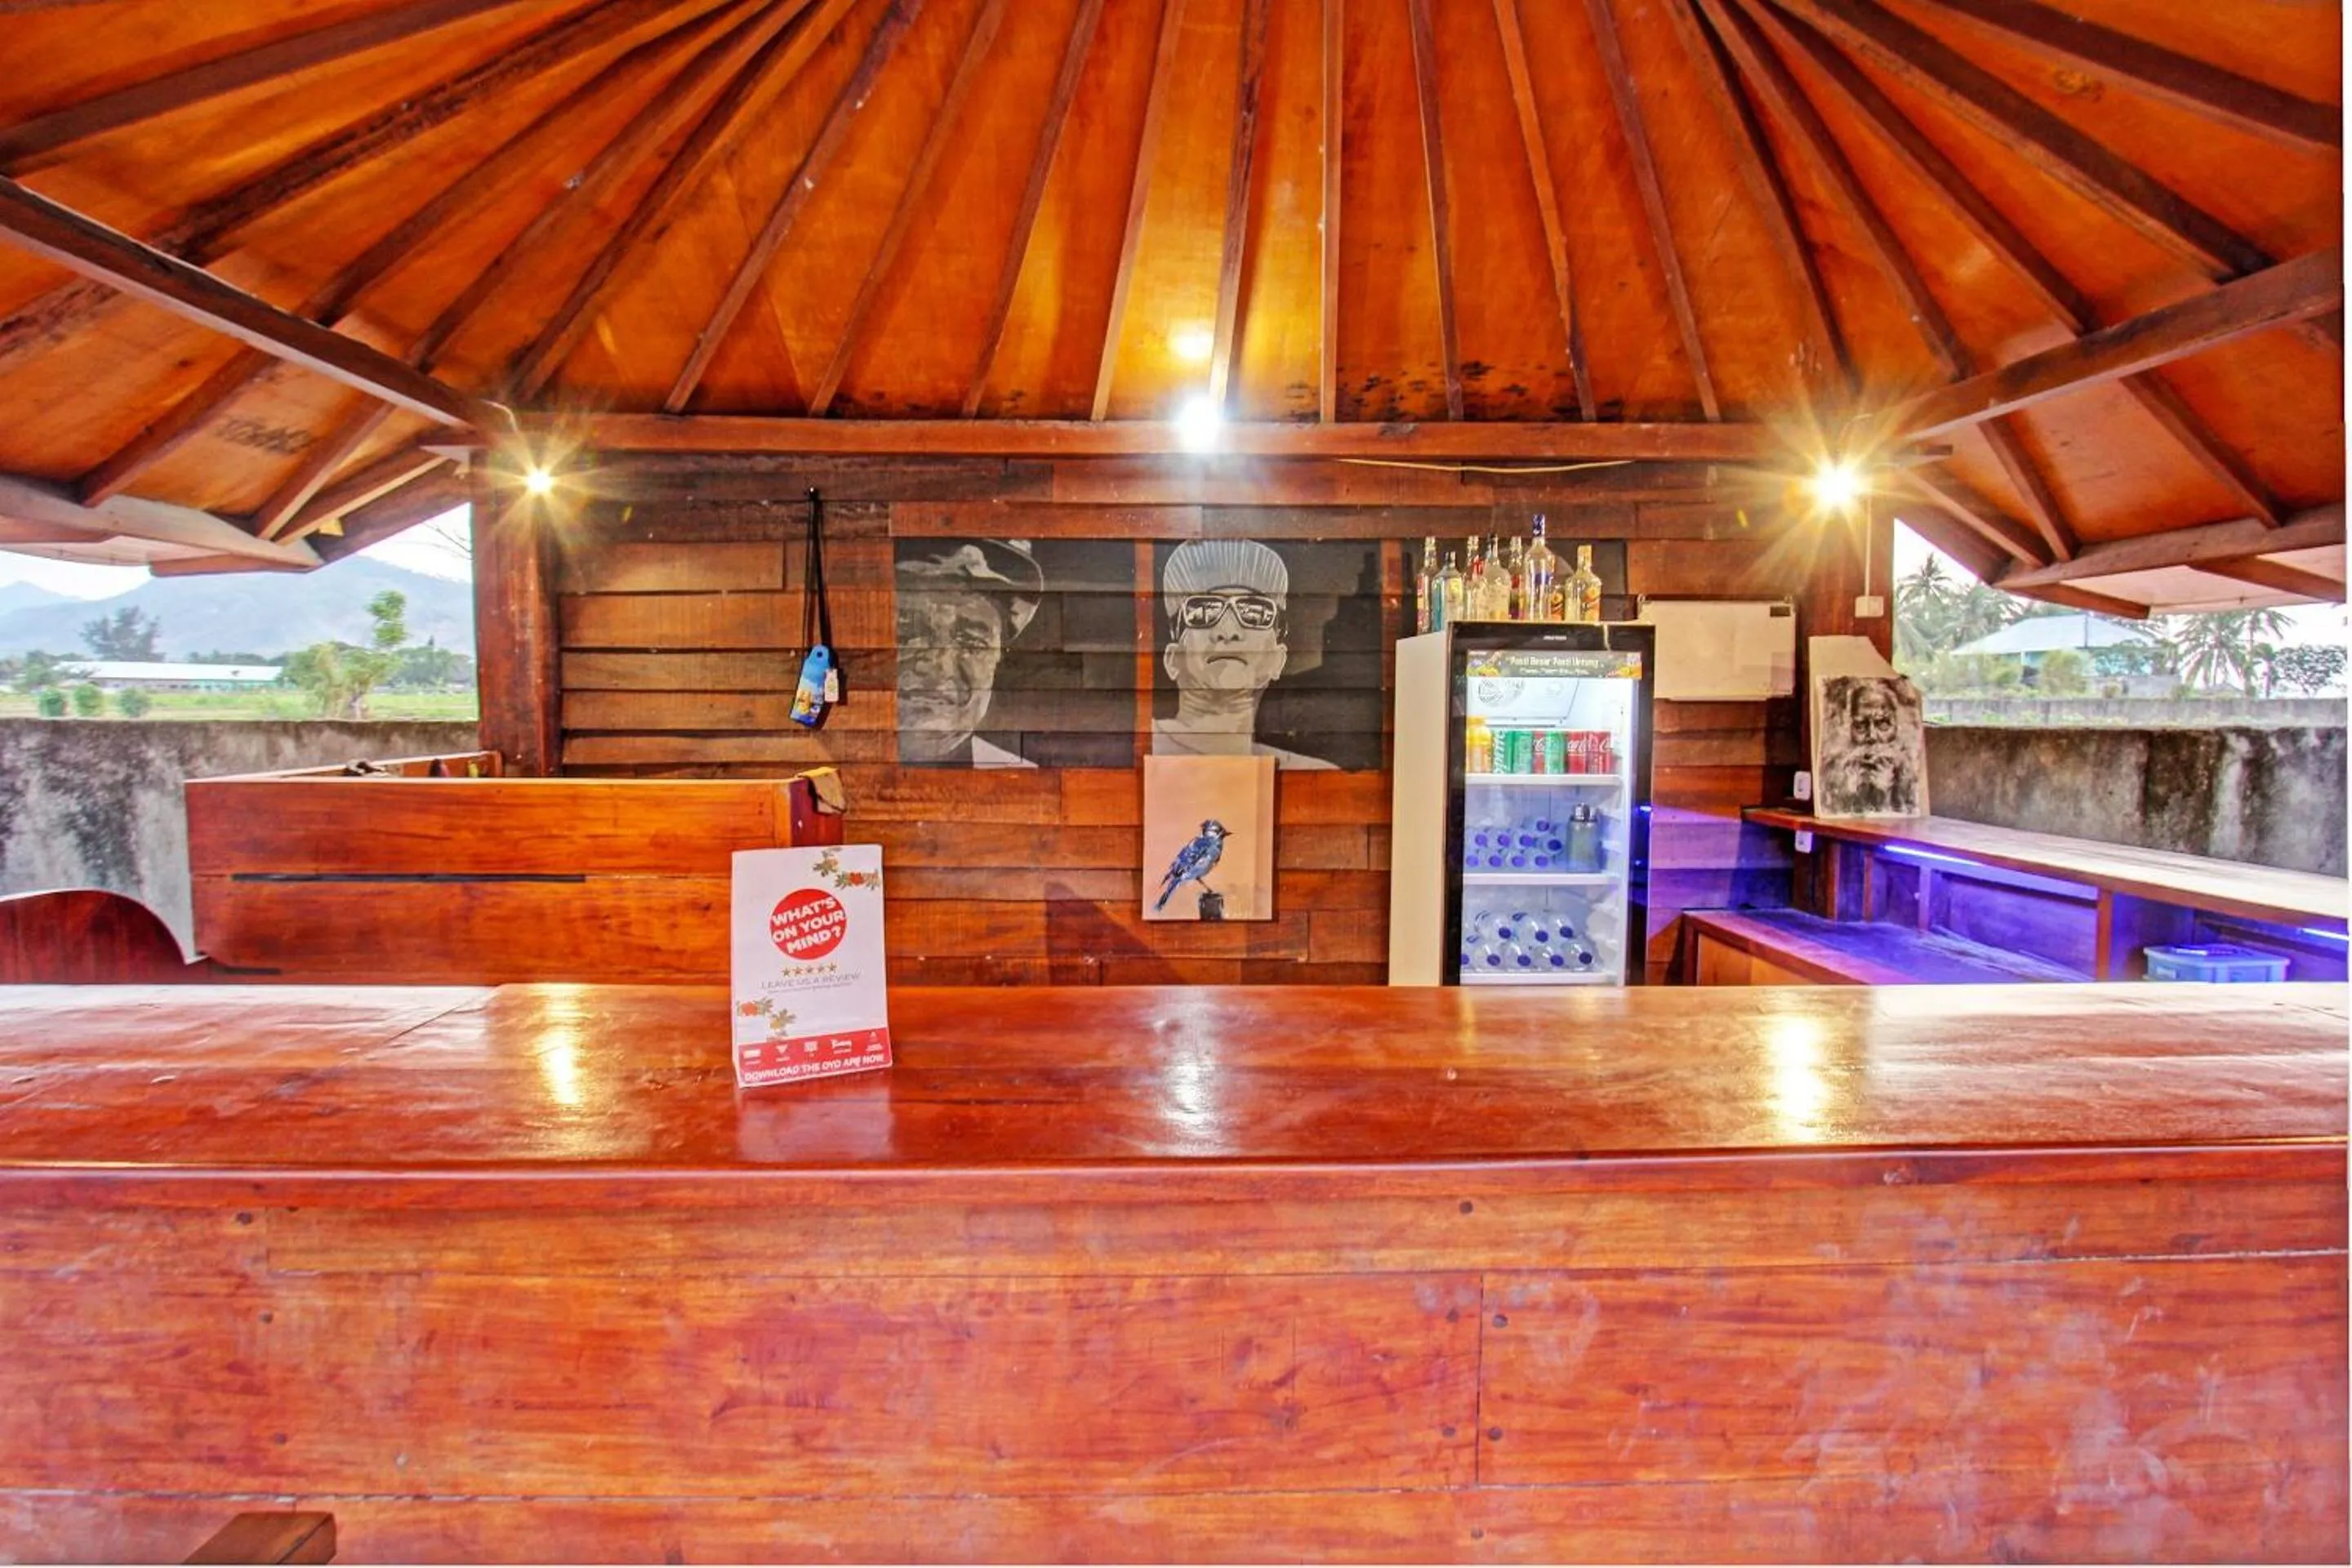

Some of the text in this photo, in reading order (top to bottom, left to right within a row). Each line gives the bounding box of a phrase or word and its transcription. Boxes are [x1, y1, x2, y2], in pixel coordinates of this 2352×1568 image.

[772, 896, 836, 927] WHAT'S
[773, 909, 845, 943] ON YOUR
[786, 924, 842, 955] MIND?
[744, 1065, 800, 1081] DOWNLOAD
[802, 1062, 820, 1073] THE
[822, 1058, 842, 1071] OYO
[862, 1053, 885, 1065] NOW
